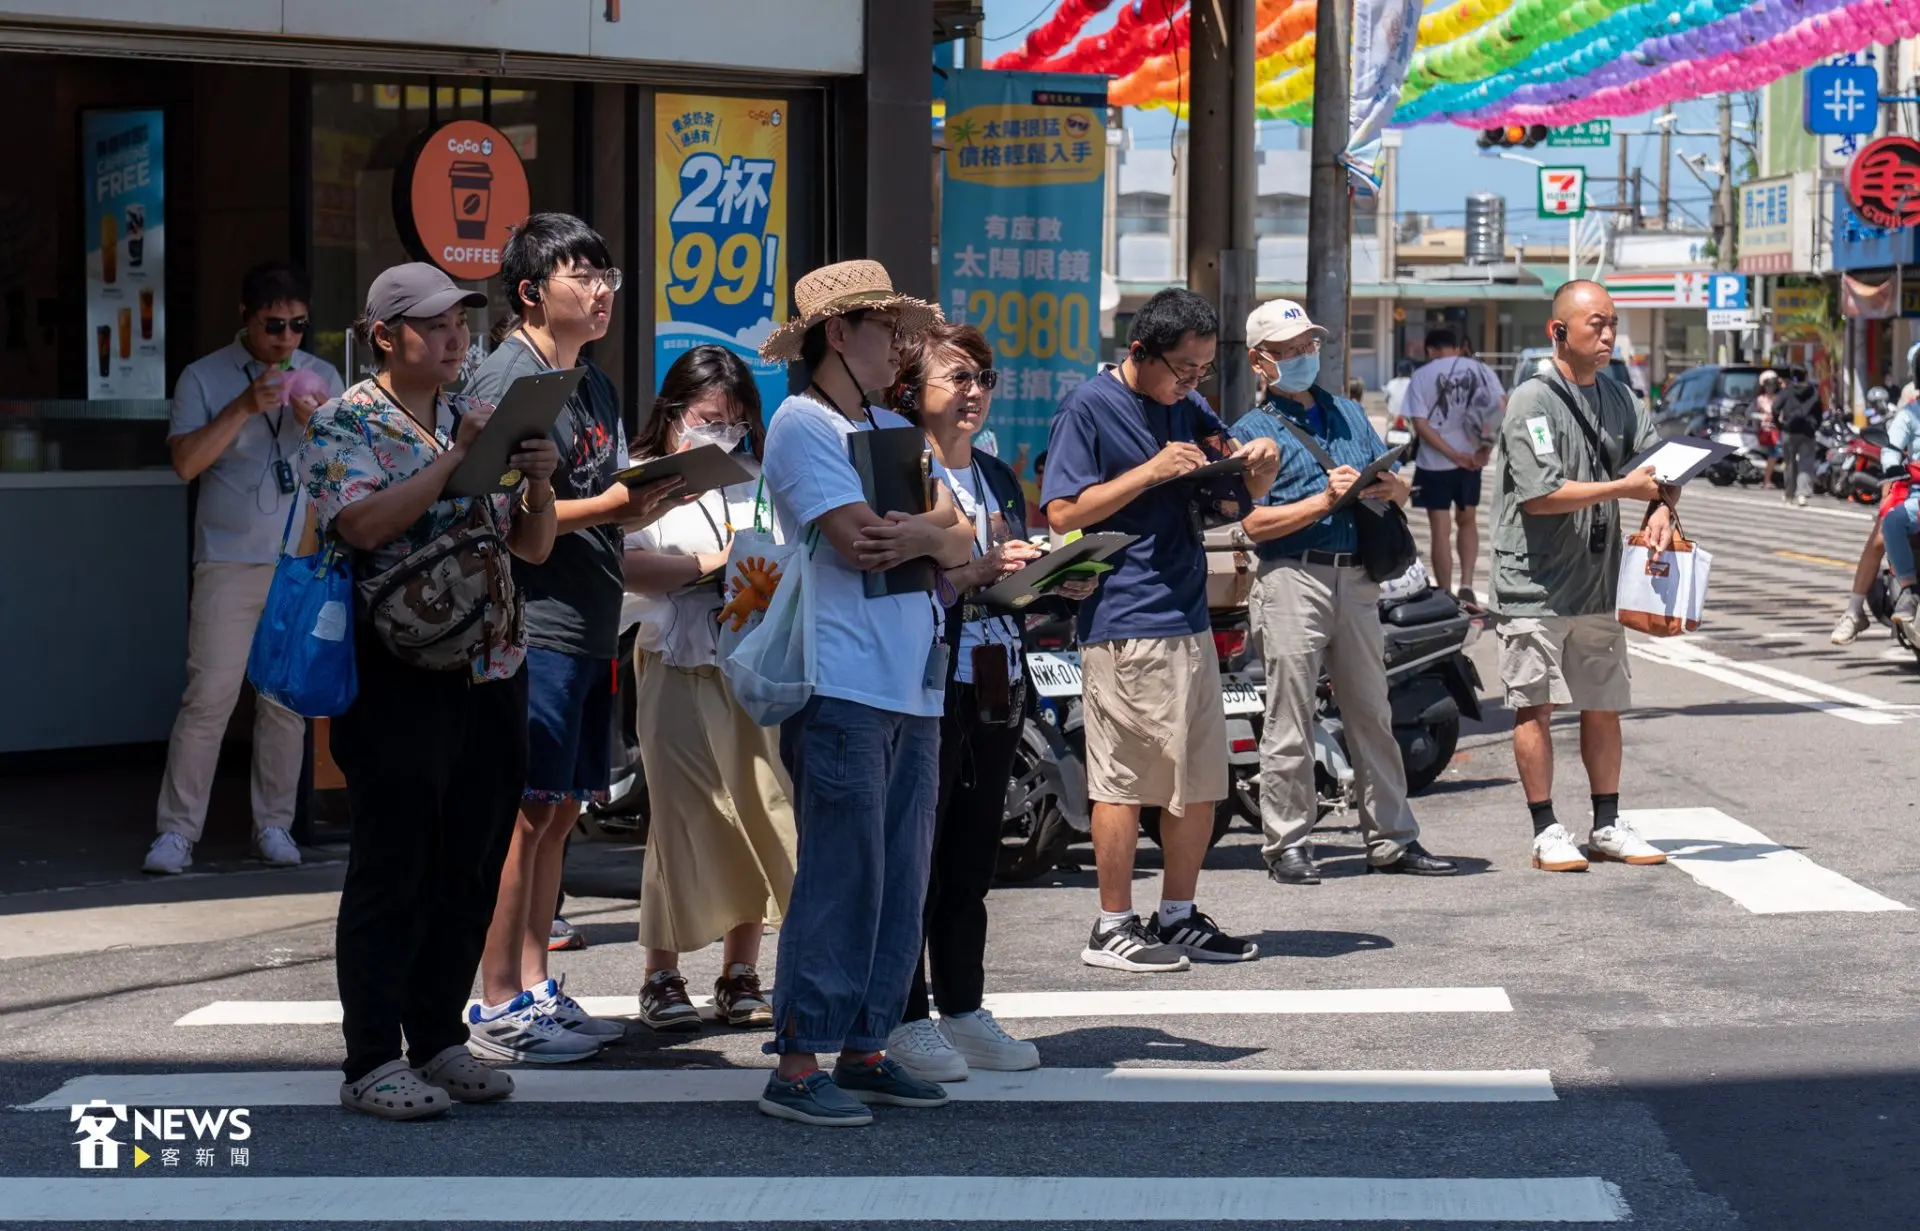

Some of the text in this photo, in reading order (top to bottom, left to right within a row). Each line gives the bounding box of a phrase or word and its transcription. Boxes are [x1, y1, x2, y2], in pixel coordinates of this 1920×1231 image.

[983, 117, 1061, 140] 太陽很猛
[448, 138, 480, 154] CoCo
[97, 159, 151, 203] FREE
[670, 154, 775, 224] 2杯
[984, 213, 1064, 242] 有度數
[443, 246, 500, 264] COFFEE
[668, 231, 777, 307] 99!
[953, 244, 1091, 283] 太陽眼鏡
[1715, 276, 1740, 308] P
